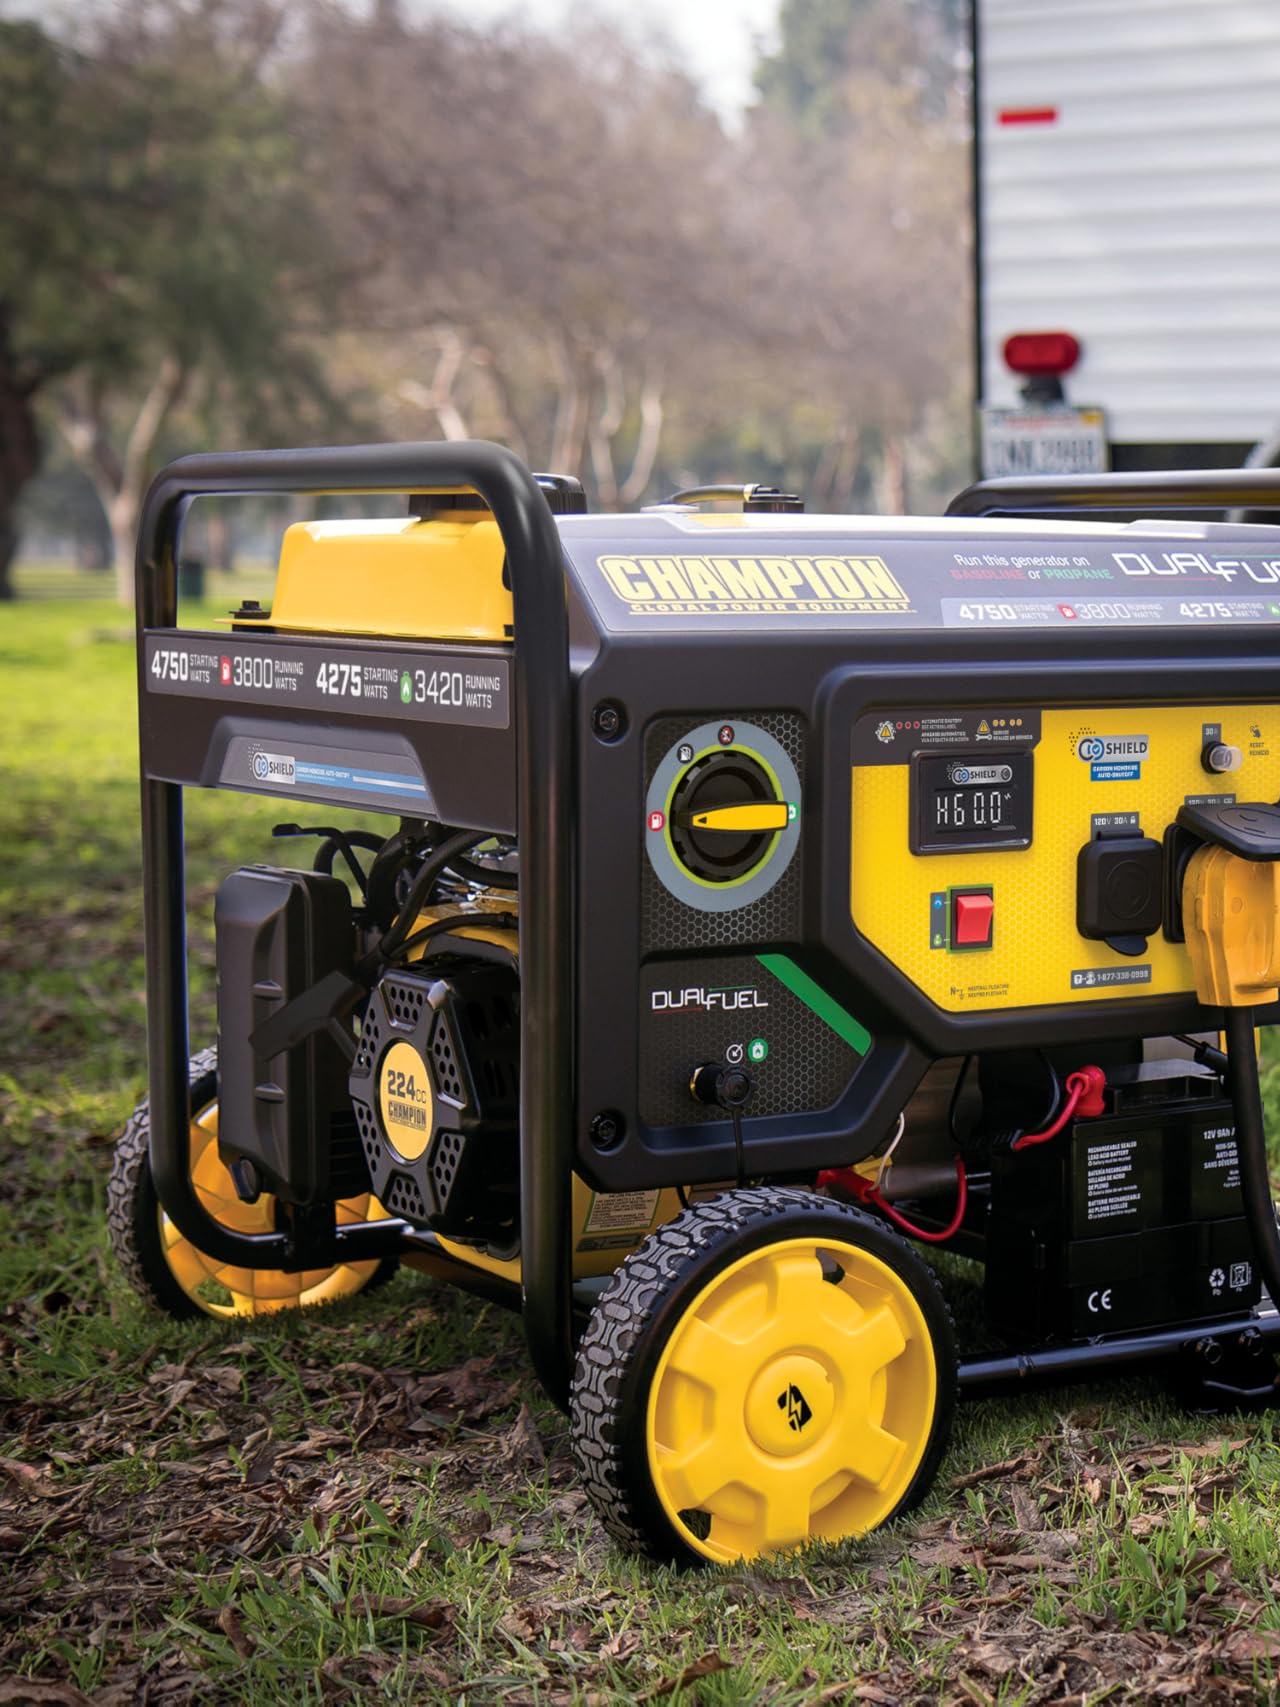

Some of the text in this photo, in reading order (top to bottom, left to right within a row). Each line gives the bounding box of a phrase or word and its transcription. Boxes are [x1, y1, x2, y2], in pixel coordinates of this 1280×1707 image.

[953, 554, 1090, 569] Run this generator on
[602, 557, 905, 600] CHAMPION
[949, 568, 1114, 581] GASOLINE or PROPANE
[630, 601, 911, 613] GLOBAL POWER EQUIPMENT
[959, 604, 1017, 620] 4750
[1074, 603, 1132, 620] 3800
[1179, 602, 1232, 618] 4275
[151, 650, 304, 691] 4750 STARTING WATTS 3800 RUNNING WATTS
[316, 663, 501, 709] 4275 STARTING WATTS 3420 RUNNING WATTS
[1106, 742, 1148, 755] SHIELD
[269, 761, 294, 777] SHIELD
[970, 770, 997, 780] SHIELD
[1094, 816, 1111, 826] 120V
[388, 1101, 426, 1126] CHAMPION
[1203, 1129, 1216, 1140] 12V
[1217, 1127, 1231, 1138] 9Ah
[1087, 1289, 1112, 1312] CE
